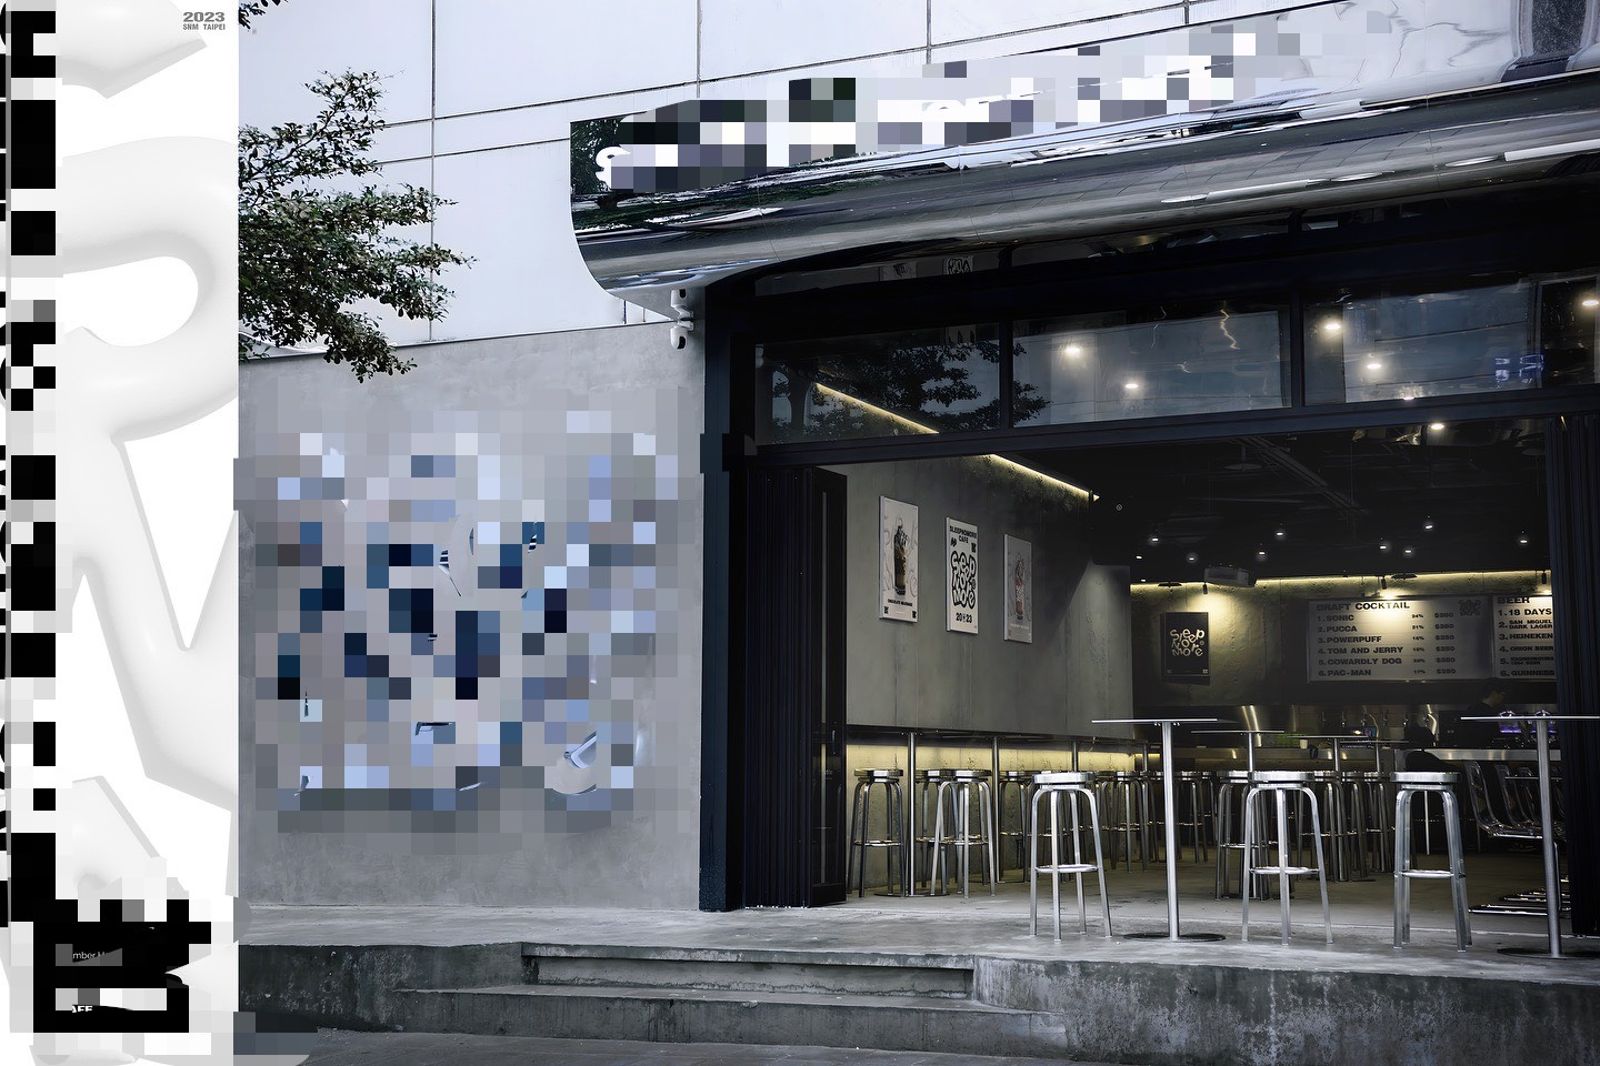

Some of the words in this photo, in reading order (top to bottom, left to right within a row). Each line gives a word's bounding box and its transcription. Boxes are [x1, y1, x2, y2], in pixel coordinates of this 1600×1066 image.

[1355, 601, 1410, 610] COCKTAIL
[1524, 608, 1552, 616] DAYS
[1170, 628, 1205, 644] Sleep
[1373, 646, 1404, 654] JERRY
[1382, 657, 1402, 665] DOG
